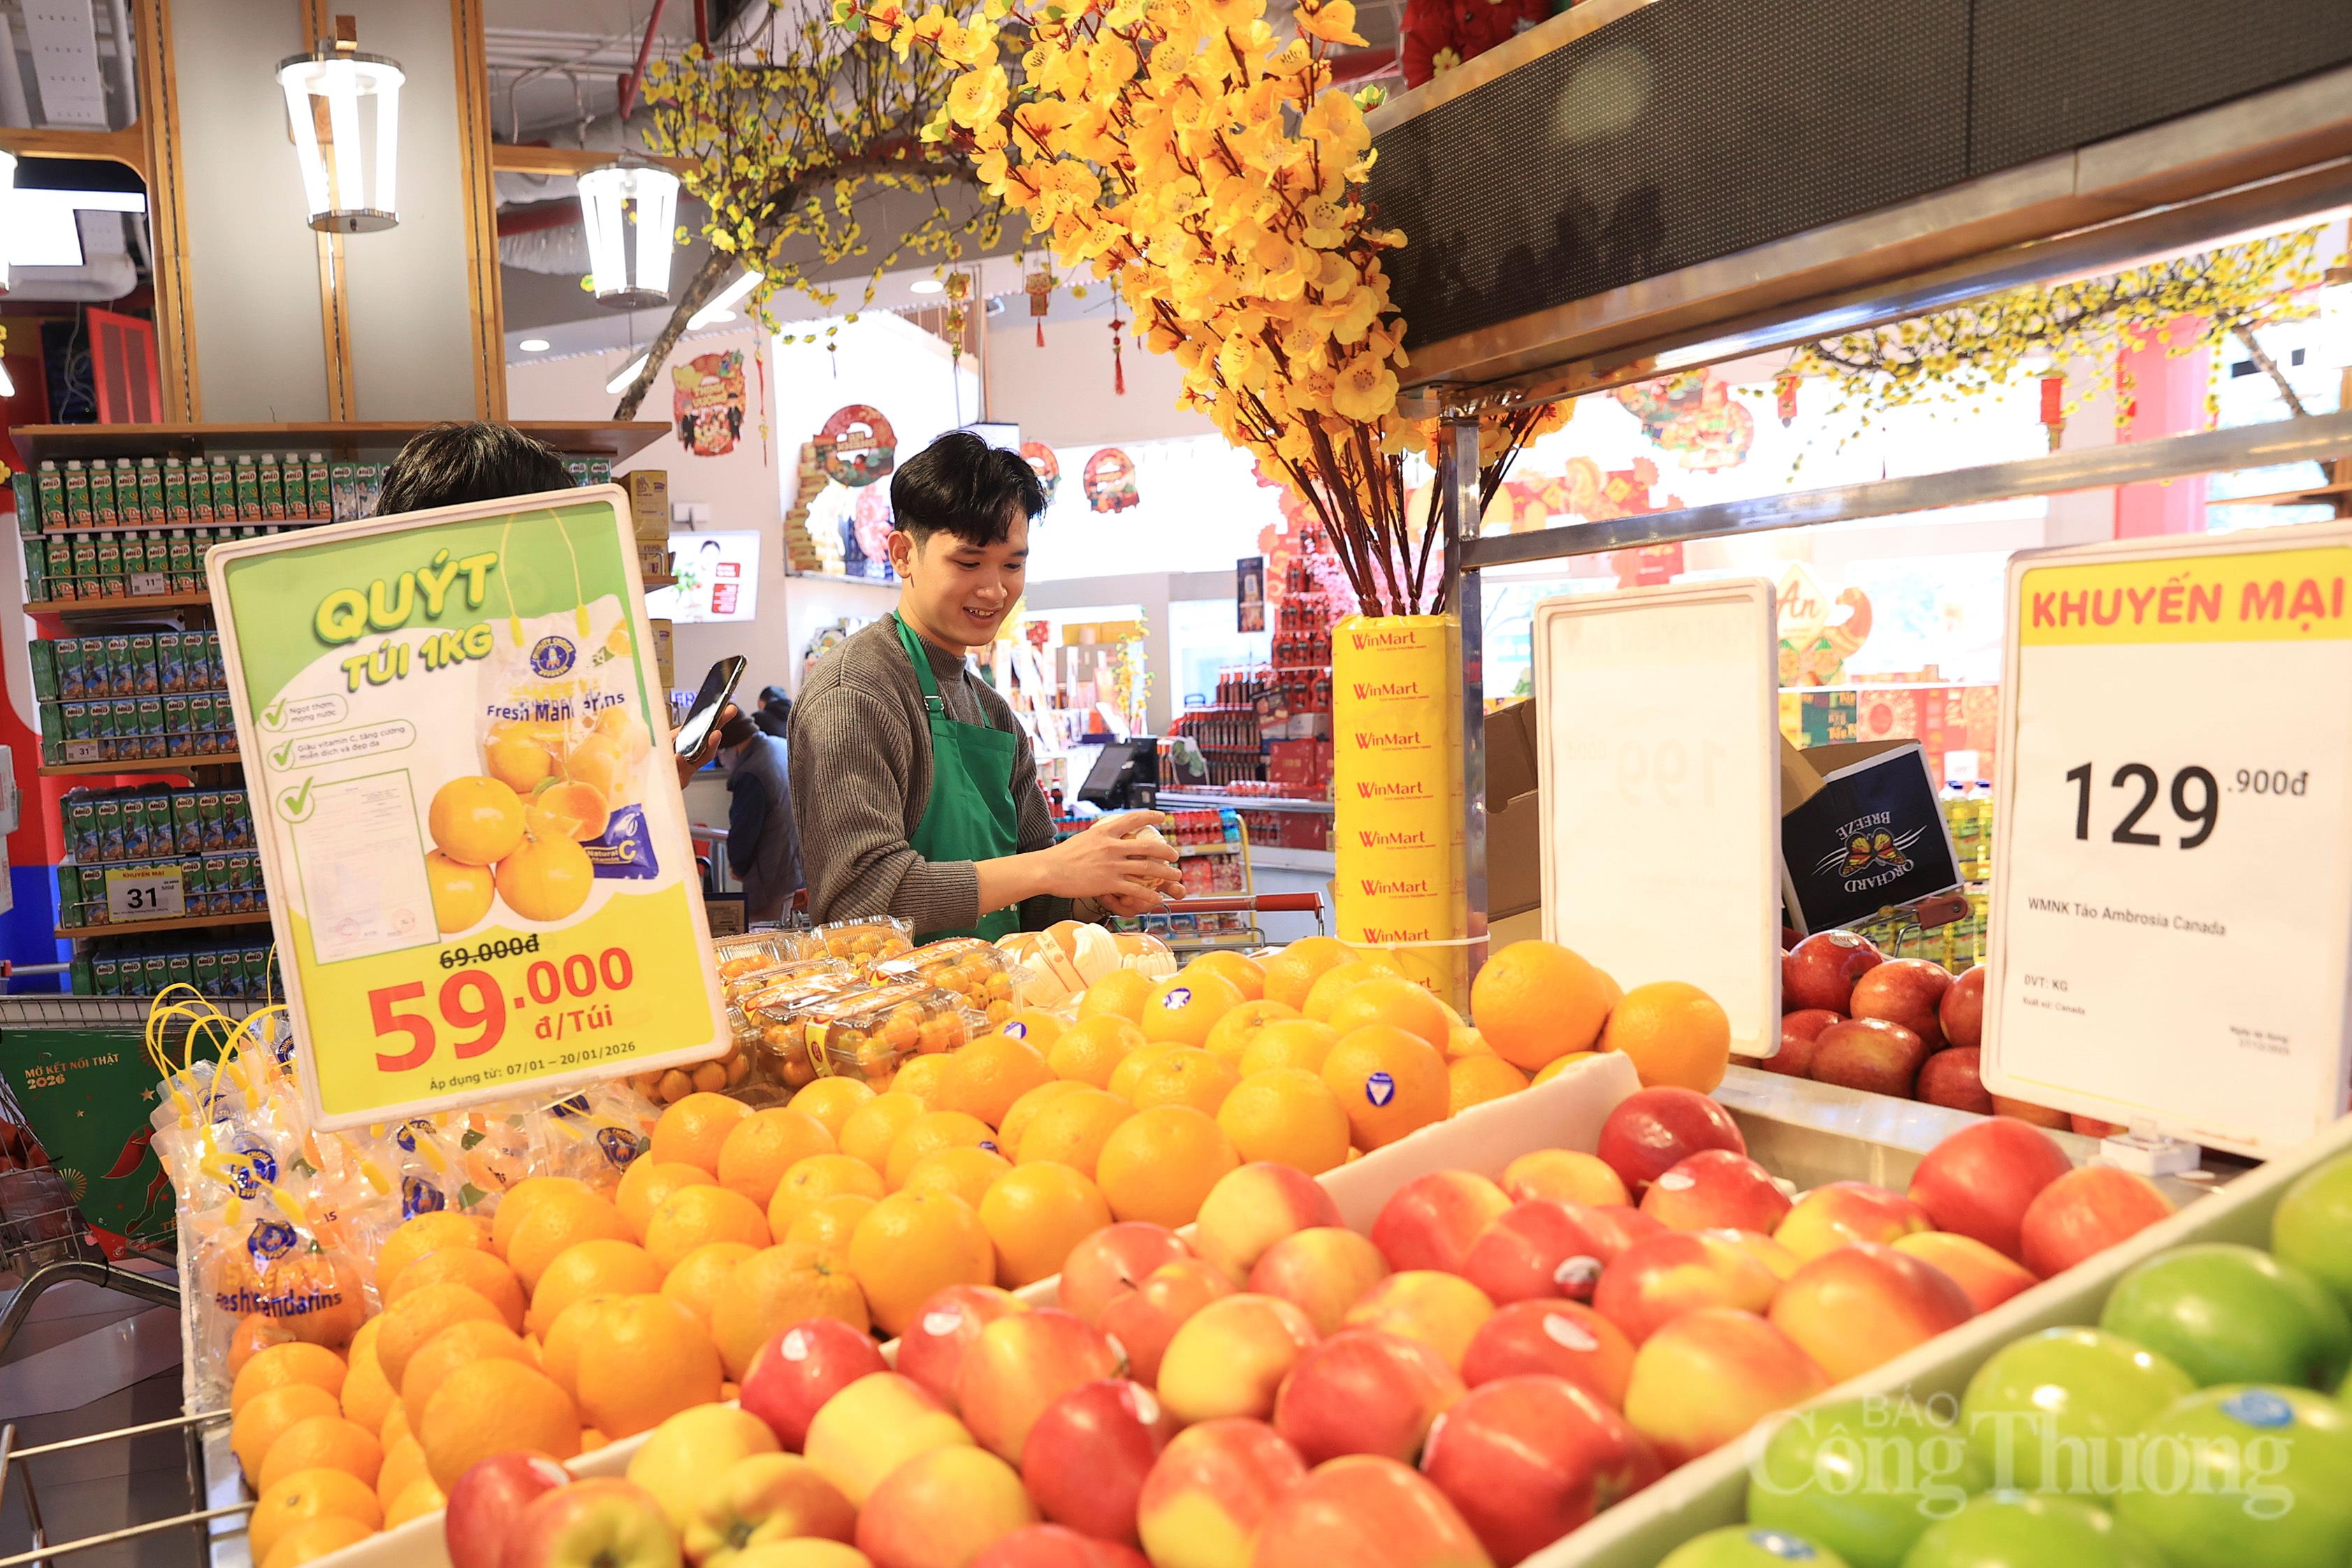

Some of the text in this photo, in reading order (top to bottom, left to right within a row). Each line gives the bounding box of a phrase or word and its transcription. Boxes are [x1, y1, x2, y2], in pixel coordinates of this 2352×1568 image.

[313, 548, 498, 648] QUÝT
[2032, 571, 2345, 634] KHUYẾN MẠI
[1351, 631, 1416, 651] WinMart
[341, 623, 494, 692] TÚI 1KG
[1353, 681, 1418, 700] WinMart
[319, 737, 347, 748] vitamin
[1355, 731, 1421, 749] WinMart
[1356, 781, 1423, 799] WinMart
[1835, 811, 1891, 841] BREEZE
[1359, 831, 1425, 848] WinMart
[1843, 859, 1915, 893] ORCHARD
[127, 887, 157, 909] 31
[1360, 879, 1428, 896] WinMart
[2027, 896, 2227, 937] WMNK Táo Ambrosia Canada
[1363, 928, 1430, 943] WinMart
[440, 934, 539, 969] 69.000đ
[2052, 978, 2068, 993] KG
[535, 1003, 613, 1041] đ/Túi
[24, 1065, 43, 1079] MỞ
[91, 1052, 119, 1066] THẬT
[507, 1059, 545, 1076] 07/01
[560, 1042, 636, 1065] 20/01/2026
[27, 1073, 66, 1090] 2026
